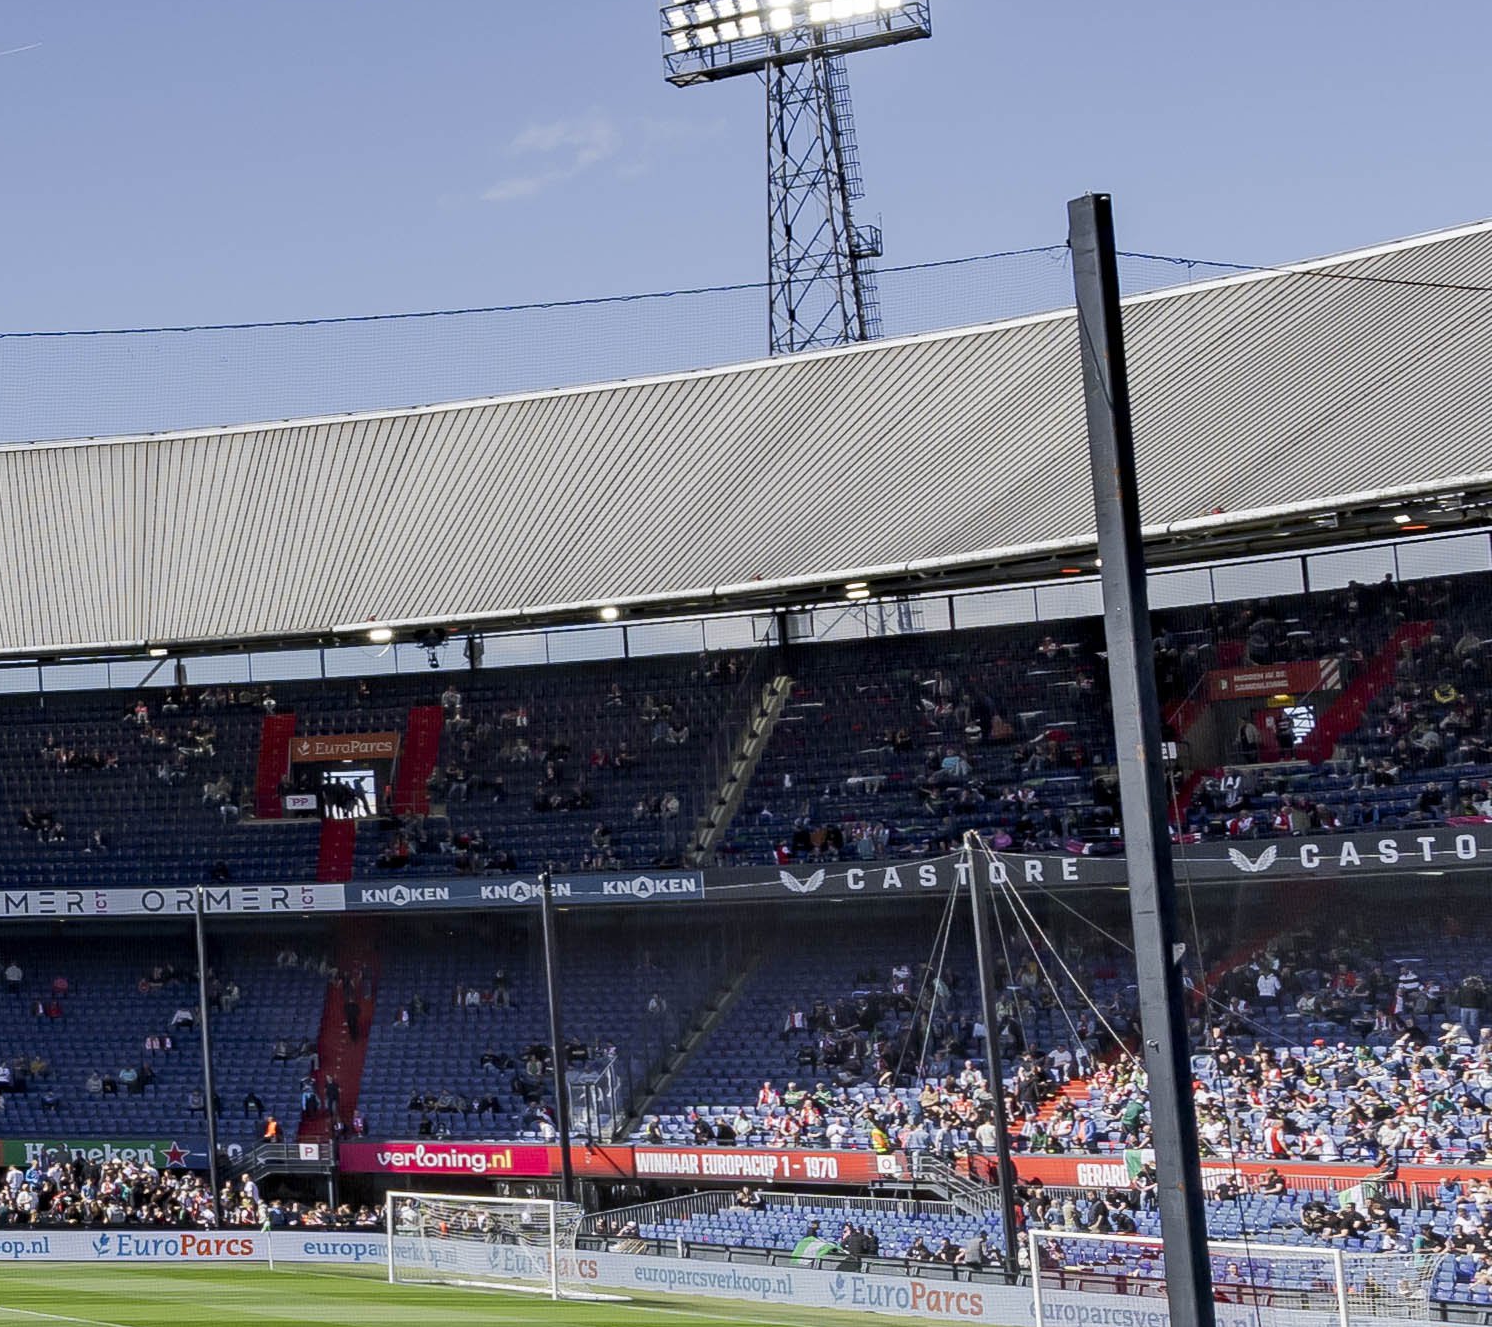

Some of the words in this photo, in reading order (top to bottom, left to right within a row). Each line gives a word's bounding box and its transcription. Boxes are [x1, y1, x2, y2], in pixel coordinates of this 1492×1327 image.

[314, 740, 393, 755] EuroParcs
[292, 796, 309, 806] PP
[847, 858, 1079, 891] CASTORE
[361, 884, 450, 906] KNAKEN
[602, 876, 696, 898] KNAKEN
[304, 1146, 314, 1157] P
[376, 1144, 512, 1173] verloning.nl
[635, 1152, 700, 1174] WINNAAR
[702, 1155, 777, 1178] EUROPACUP
[781, 1156, 790, 1177] 1
[803, 1156, 838, 1179] 1970
[881, 1158, 892, 1170] Q
[116, 1233, 254, 1257] EuroParcs
[634, 1265, 794, 1300] europarcsverkoop.nl
[851, 1275, 984, 1317] EuroParcs
